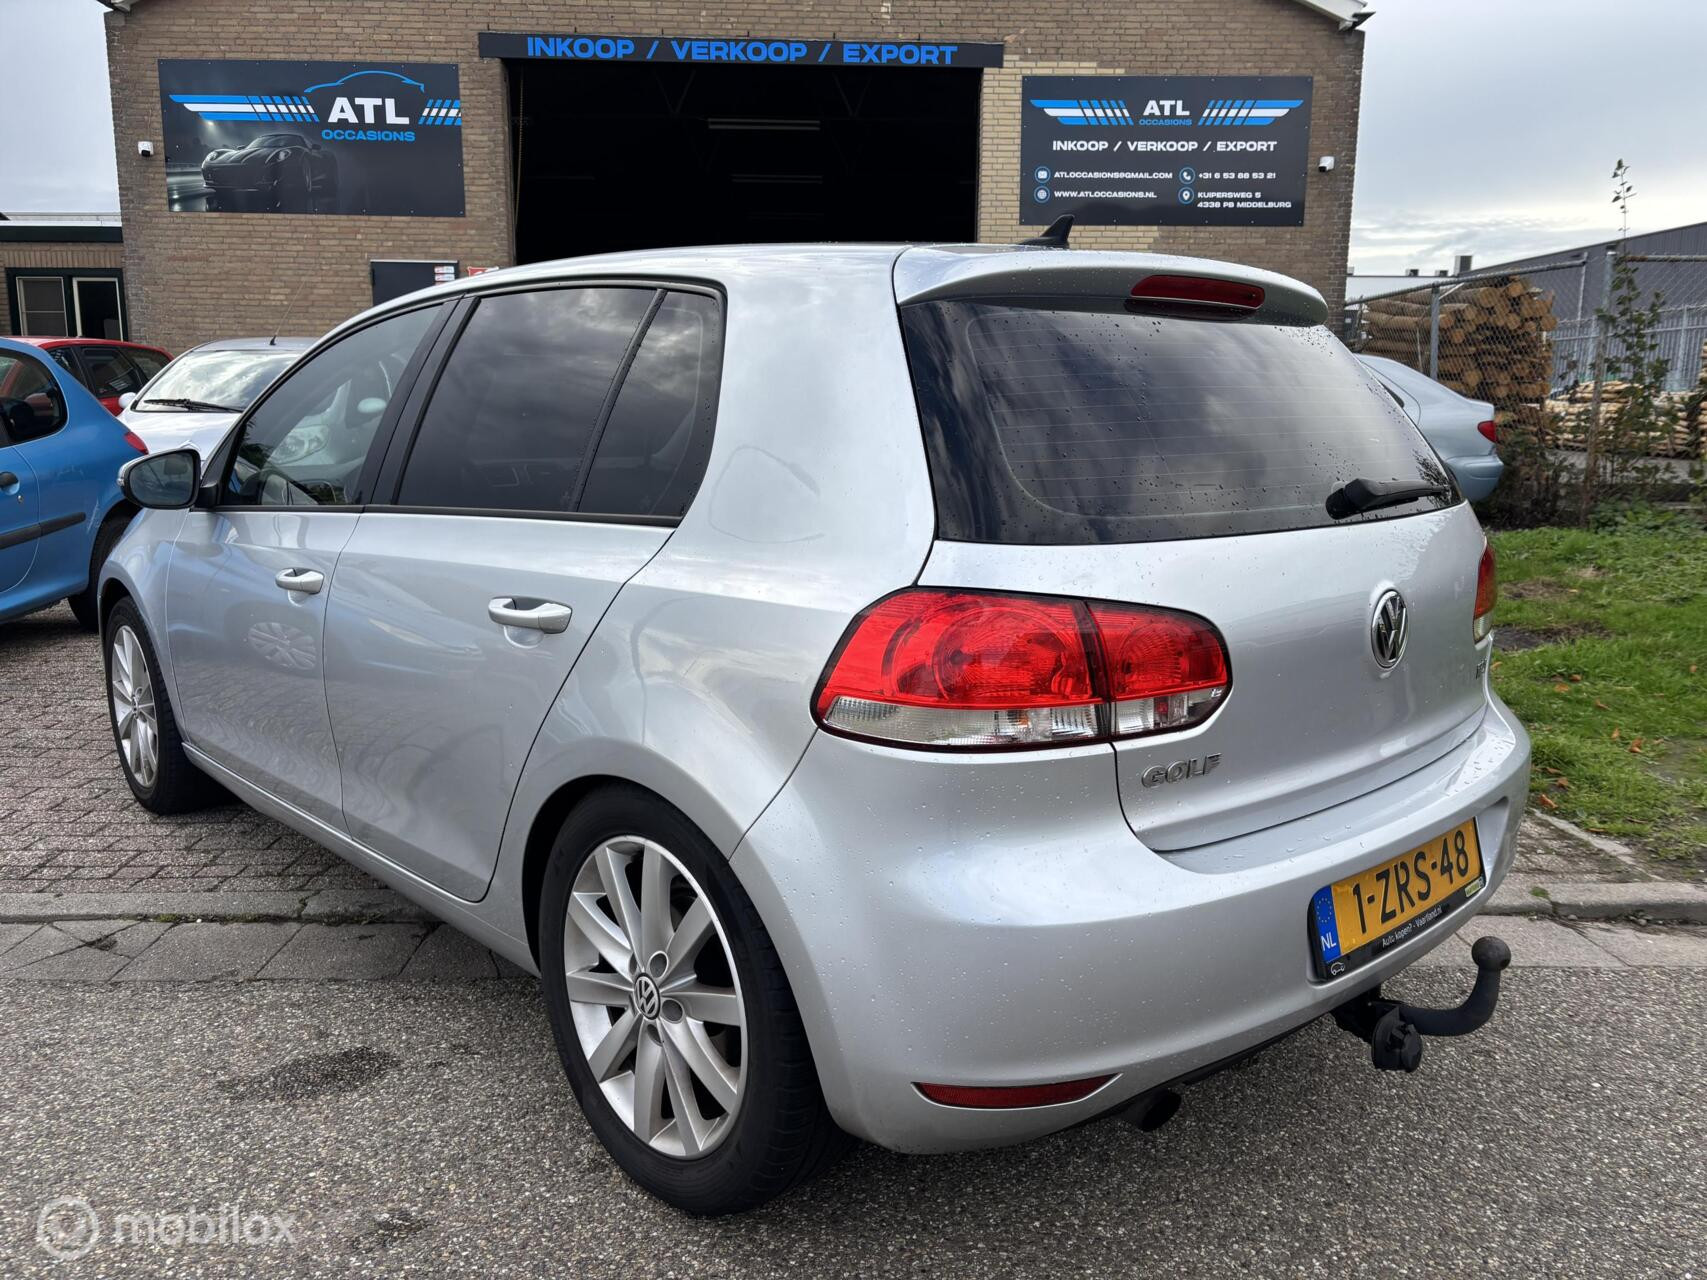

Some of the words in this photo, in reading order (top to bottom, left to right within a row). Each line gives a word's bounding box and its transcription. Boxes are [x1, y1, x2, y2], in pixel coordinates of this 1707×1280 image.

[527, 37, 634, 59] INKOOP
[646, 41, 657, 59] /
[671, 40, 807, 62] VERKOOP
[818, 43, 831, 62] /
[843, 44, 958, 65] EXPORT
[328, 97, 410, 125] ATL
[1143, 100, 1190, 116] ATL
[1139, 118, 1192, 126] OCCASIONS
[321, 129, 415, 142] OCCASIONS
[1052, 140, 1109, 151] INKOOP
[1114, 140, 1122, 152] /
[1127, 141, 1198, 151] VERKOOP
[1203, 141, 1212, 151] /
[1216, 141, 1278, 152] EXPORT
[1141, 753, 1222, 788] GOLF
[1352, 830, 1469, 934] 1-ZRS-48
[1321, 931, 1337, 951] NL
